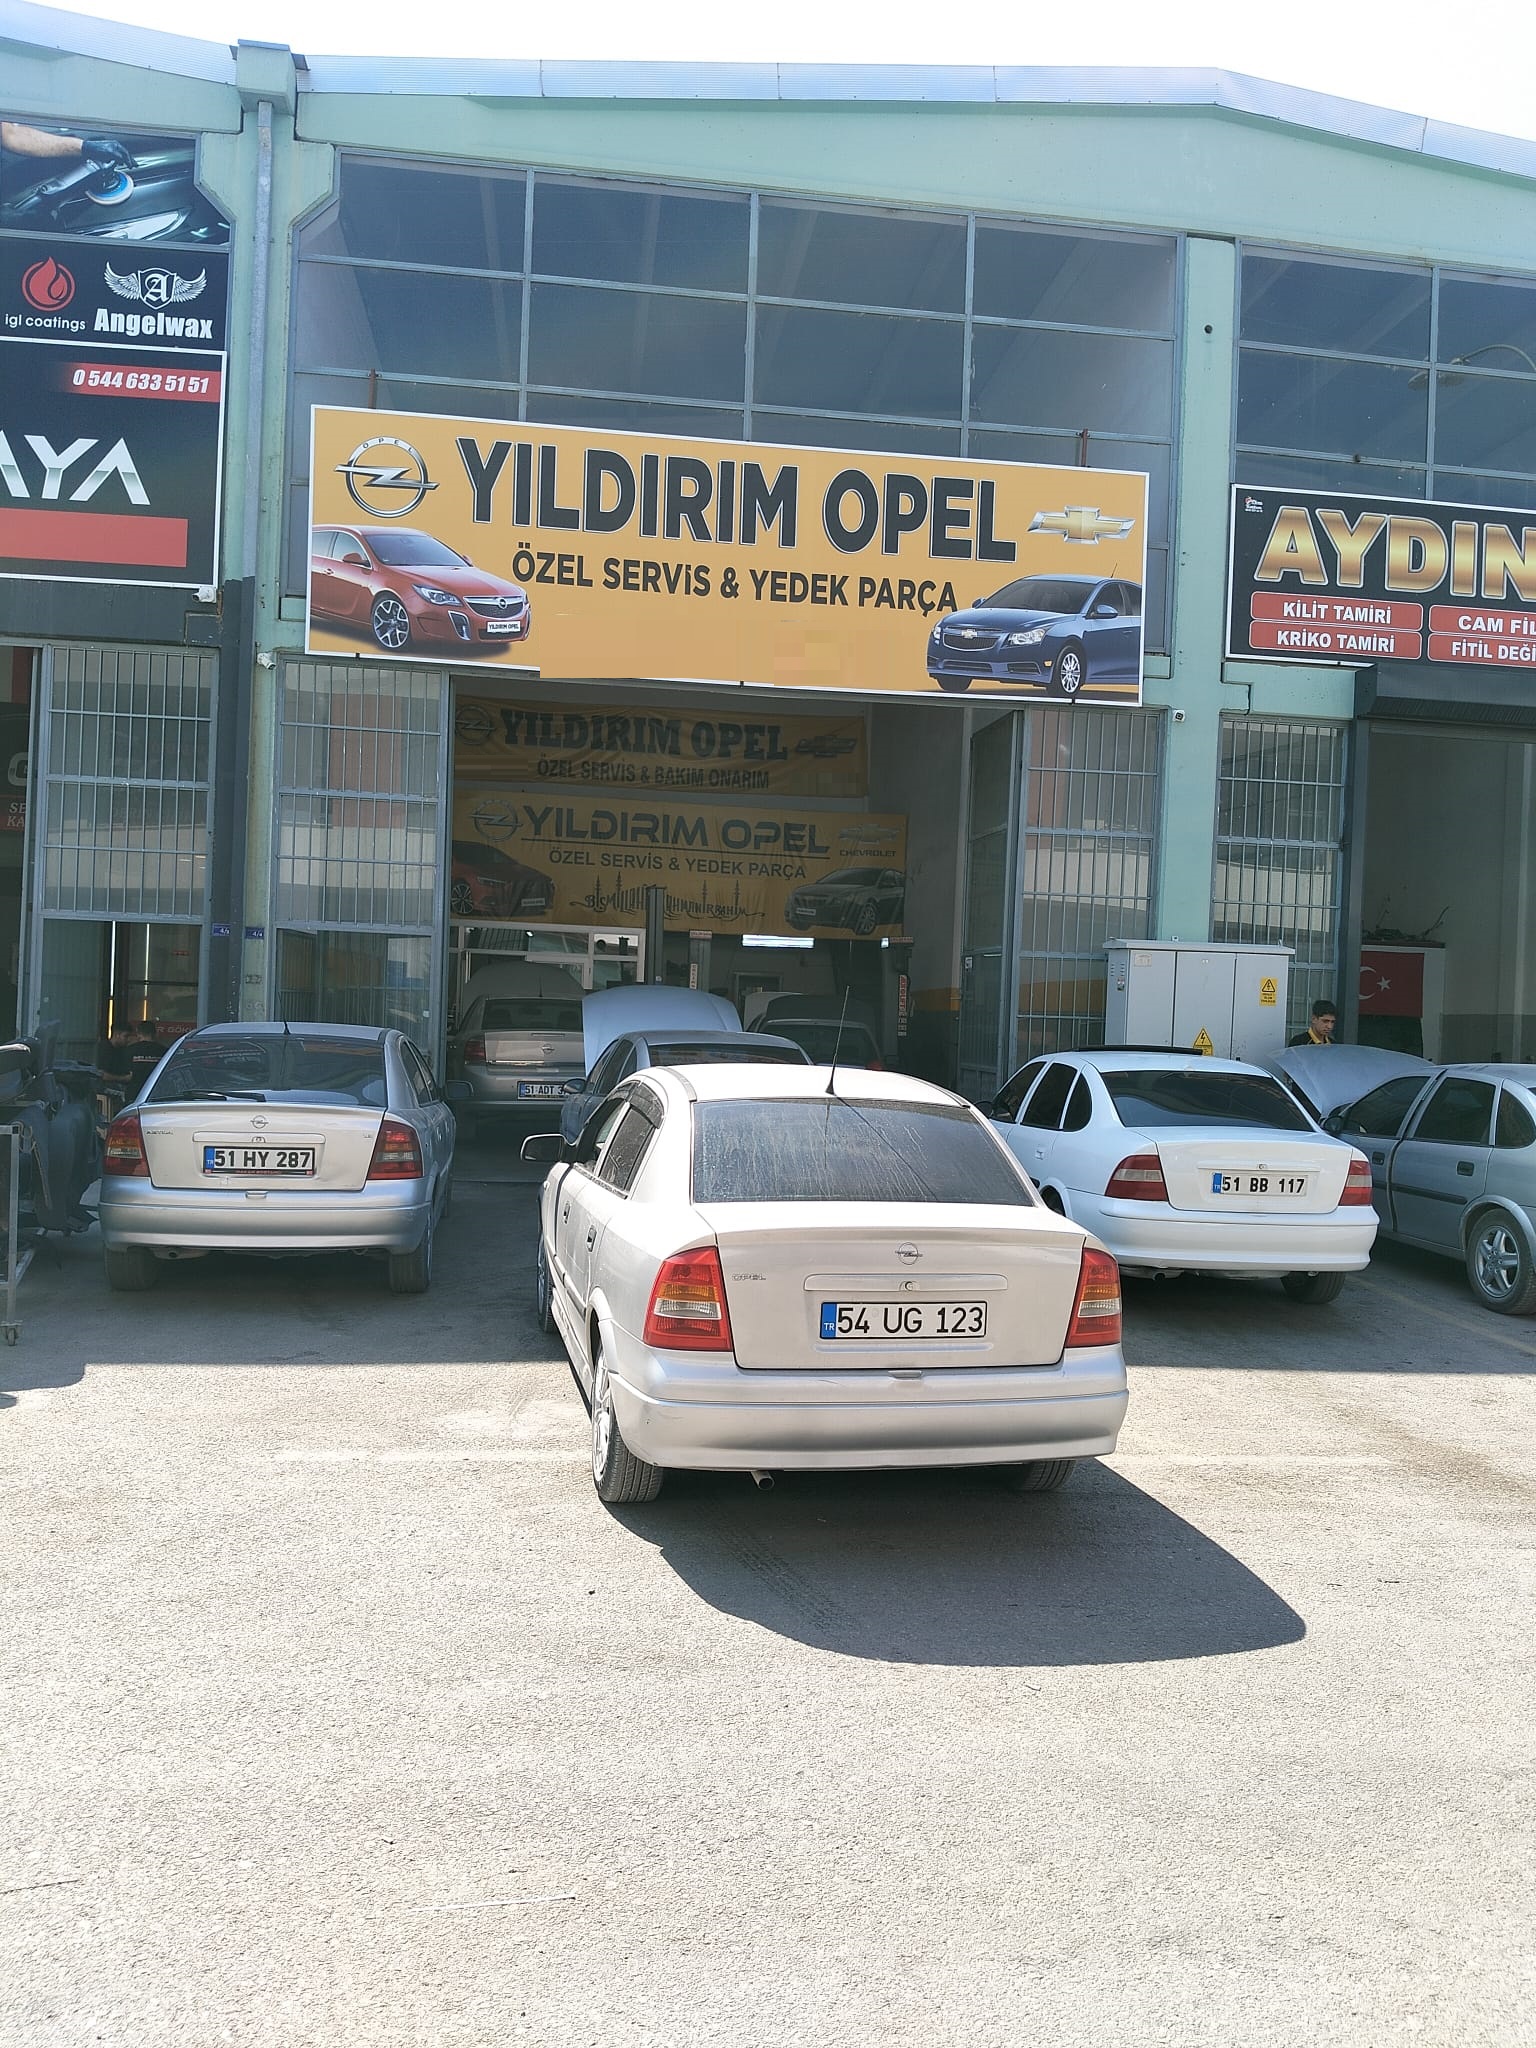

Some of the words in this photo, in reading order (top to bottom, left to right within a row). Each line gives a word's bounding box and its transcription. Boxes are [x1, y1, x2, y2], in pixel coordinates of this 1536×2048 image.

[5, 313, 22, 330] igl
[25, 315, 86, 332] coatings
[94, 308, 213, 339] Angelwax
[72, 369, 86, 386] 0
[88, 370, 122, 389] 544
[125, 372, 162, 391] 633
[164, 375, 209, 394] 5151
[455, 437, 799, 549] YILDIRIM
[822, 467, 1017, 563] OPEL
[1253, 505, 1536, 602] AYDIN
[511, 542, 593, 587] ÖZEL
[602, 557, 711, 597] SERVİS
[719, 566, 739, 599] &
[749, 568, 849, 608] YEDEK
[859, 575, 959, 617] PARÇA
[1282, 599, 1329, 619] KİLİT
[1334, 603, 1391, 624] TAMİRİ
[1458, 615, 1503, 633] CAM
[1277, 629, 1331, 647] KRİKO
[1336, 631, 1395, 653] TAMİRİ
[1452, 637, 1492, 658] FİTİL
[500, 708, 682, 755] YILDIRIM
[691, 721, 788, 760] OPEL
[537, 753, 576, 777] ÖZEL
[640, 767, 650, 784] &
[708, 768, 769, 789] ONARIM
[523, 805, 708, 847] YILDIRIM
[721, 818, 831, 854] OPEL
[549, 847, 596, 866] ÖZEL
[600, 852, 663, 870] SERVİS
[668, 857, 680, 871] &
[685, 858, 743, 876] YEDEK
[748, 862, 807, 881] PARÇA
[839, 849, 897, 858] CHEVROLET
[525, 1085, 534, 1094] 51
[538, 1085, 554, 1094] ADT
[214, 1150, 235, 1167] 51
[243, 1151, 270, 1168] HY
[276, 1151, 311, 1168] 287
[1222, 1176, 1240, 1191] 51
[1249, 1177, 1268, 1193] BB
[1278, 1178, 1305, 1193] 117
[823, 1322, 835, 1331] TR
[836, 1307, 870, 1333] 54
[883, 1307, 923, 1333] UG
[936, 1307, 984, 1333] 123
